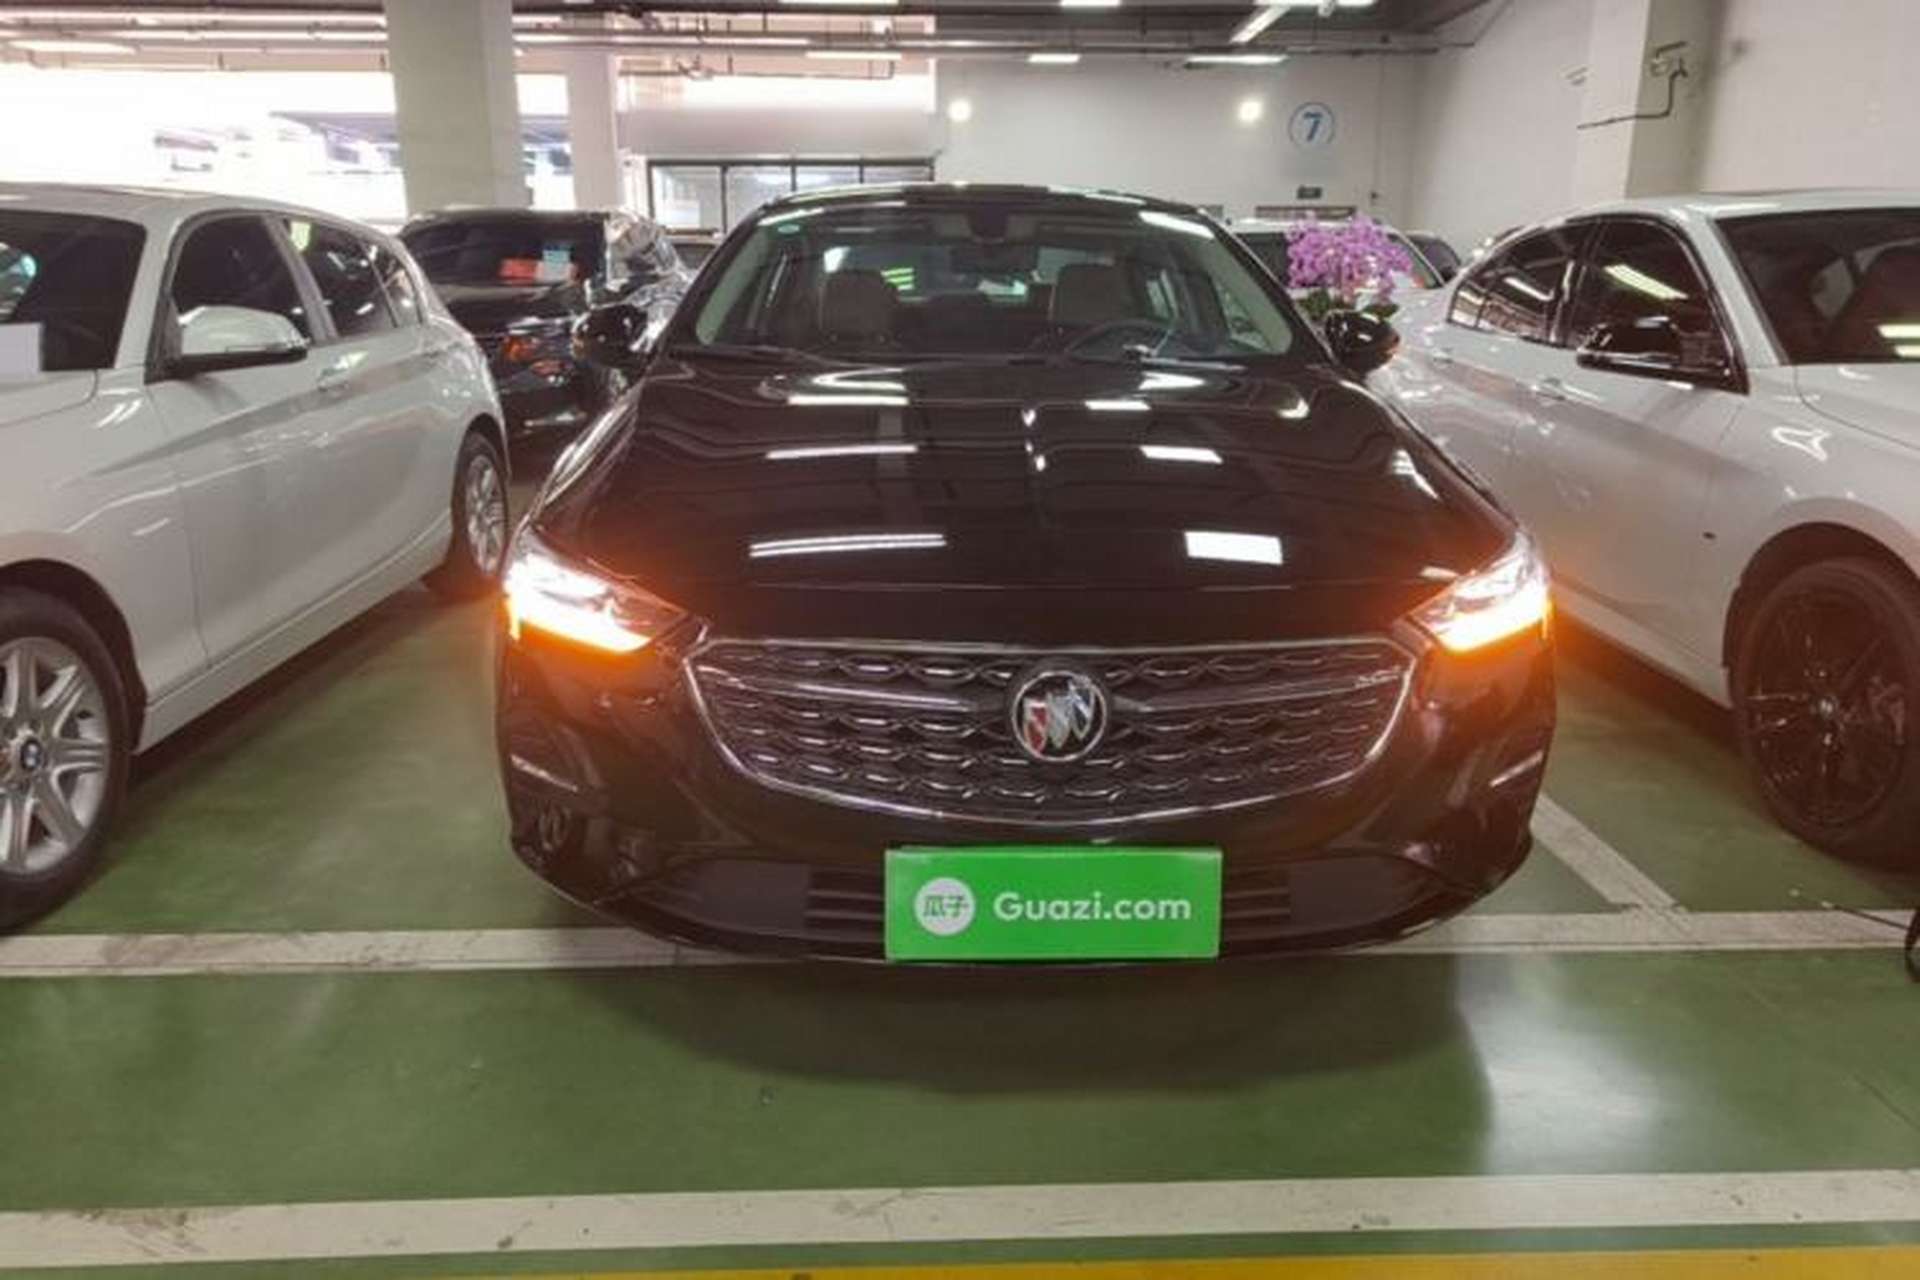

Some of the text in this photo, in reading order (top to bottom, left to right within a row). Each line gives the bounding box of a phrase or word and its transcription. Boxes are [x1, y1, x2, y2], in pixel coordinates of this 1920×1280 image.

[1303, 112, 1323, 142] 7
[923, 895, 969, 918] 瓜子
[993, 891, 1192, 921] Guazi.com
